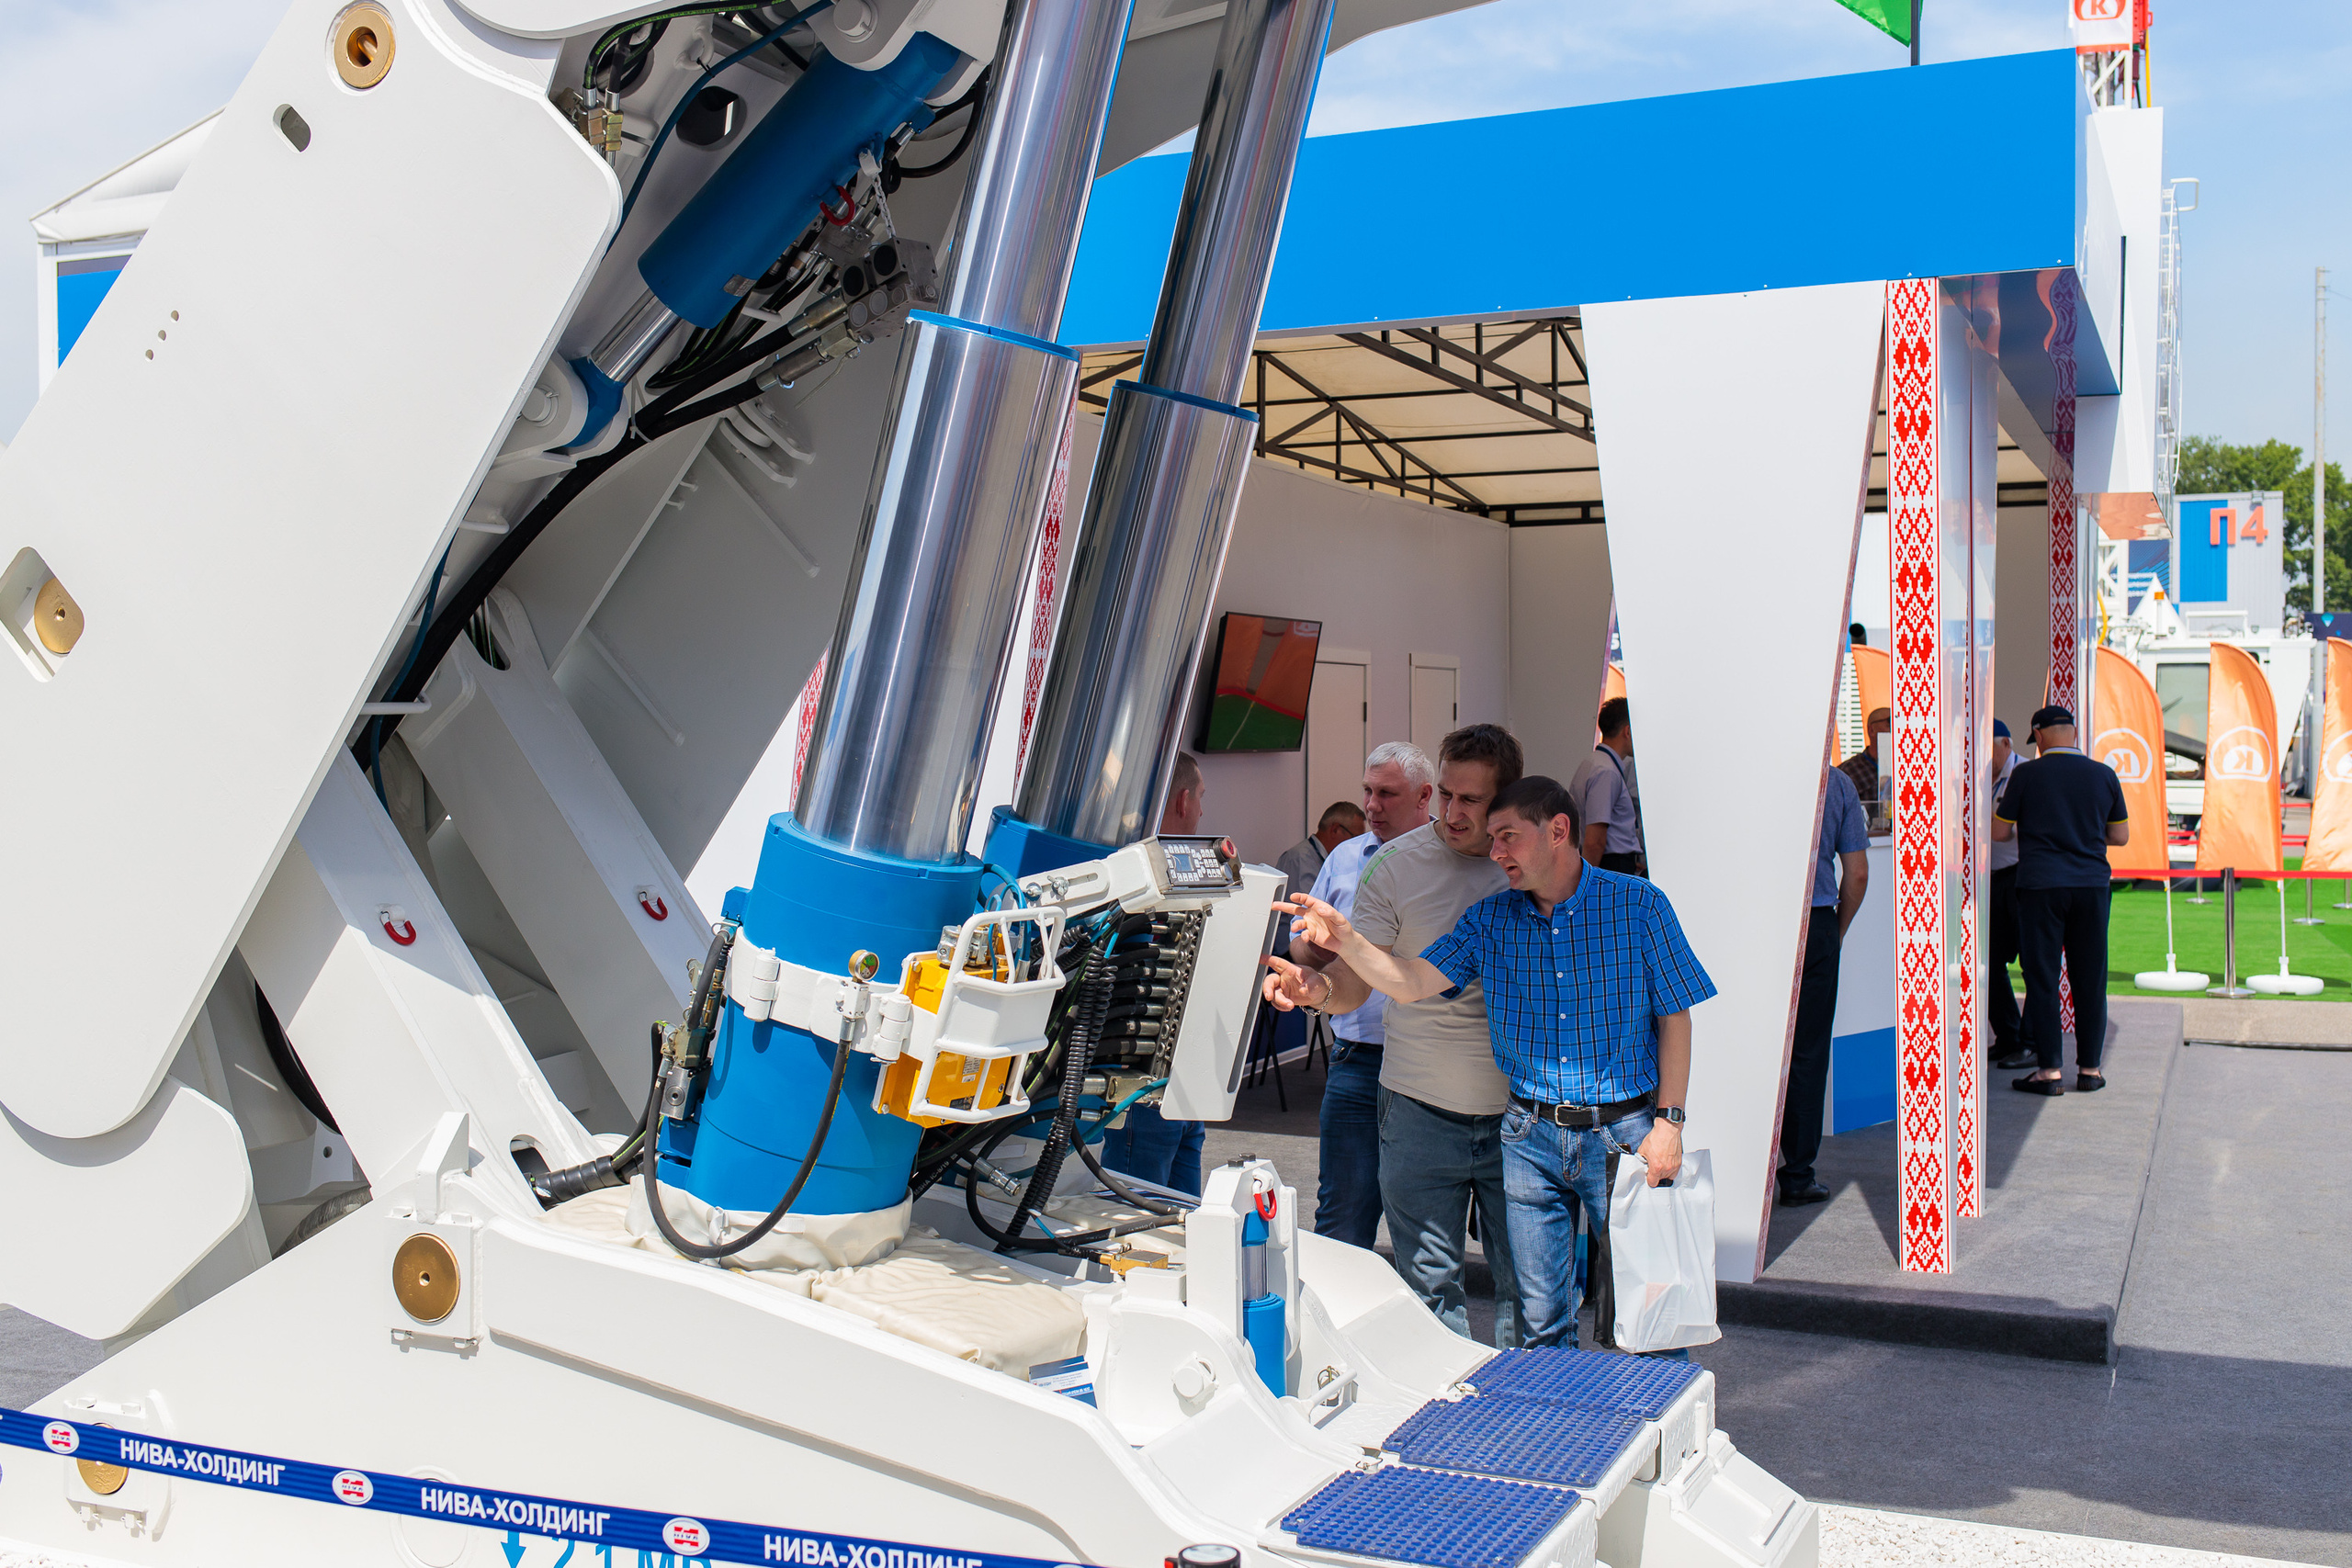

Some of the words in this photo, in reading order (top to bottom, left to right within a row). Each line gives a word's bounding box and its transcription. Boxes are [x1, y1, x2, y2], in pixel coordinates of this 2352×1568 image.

[2210, 506, 2268, 545] П4
[120, 1438, 286, 1486] НИВА-ХОЛДИНГ
[421, 1487, 611, 1537] НИВА-ХОЛДИНГ
